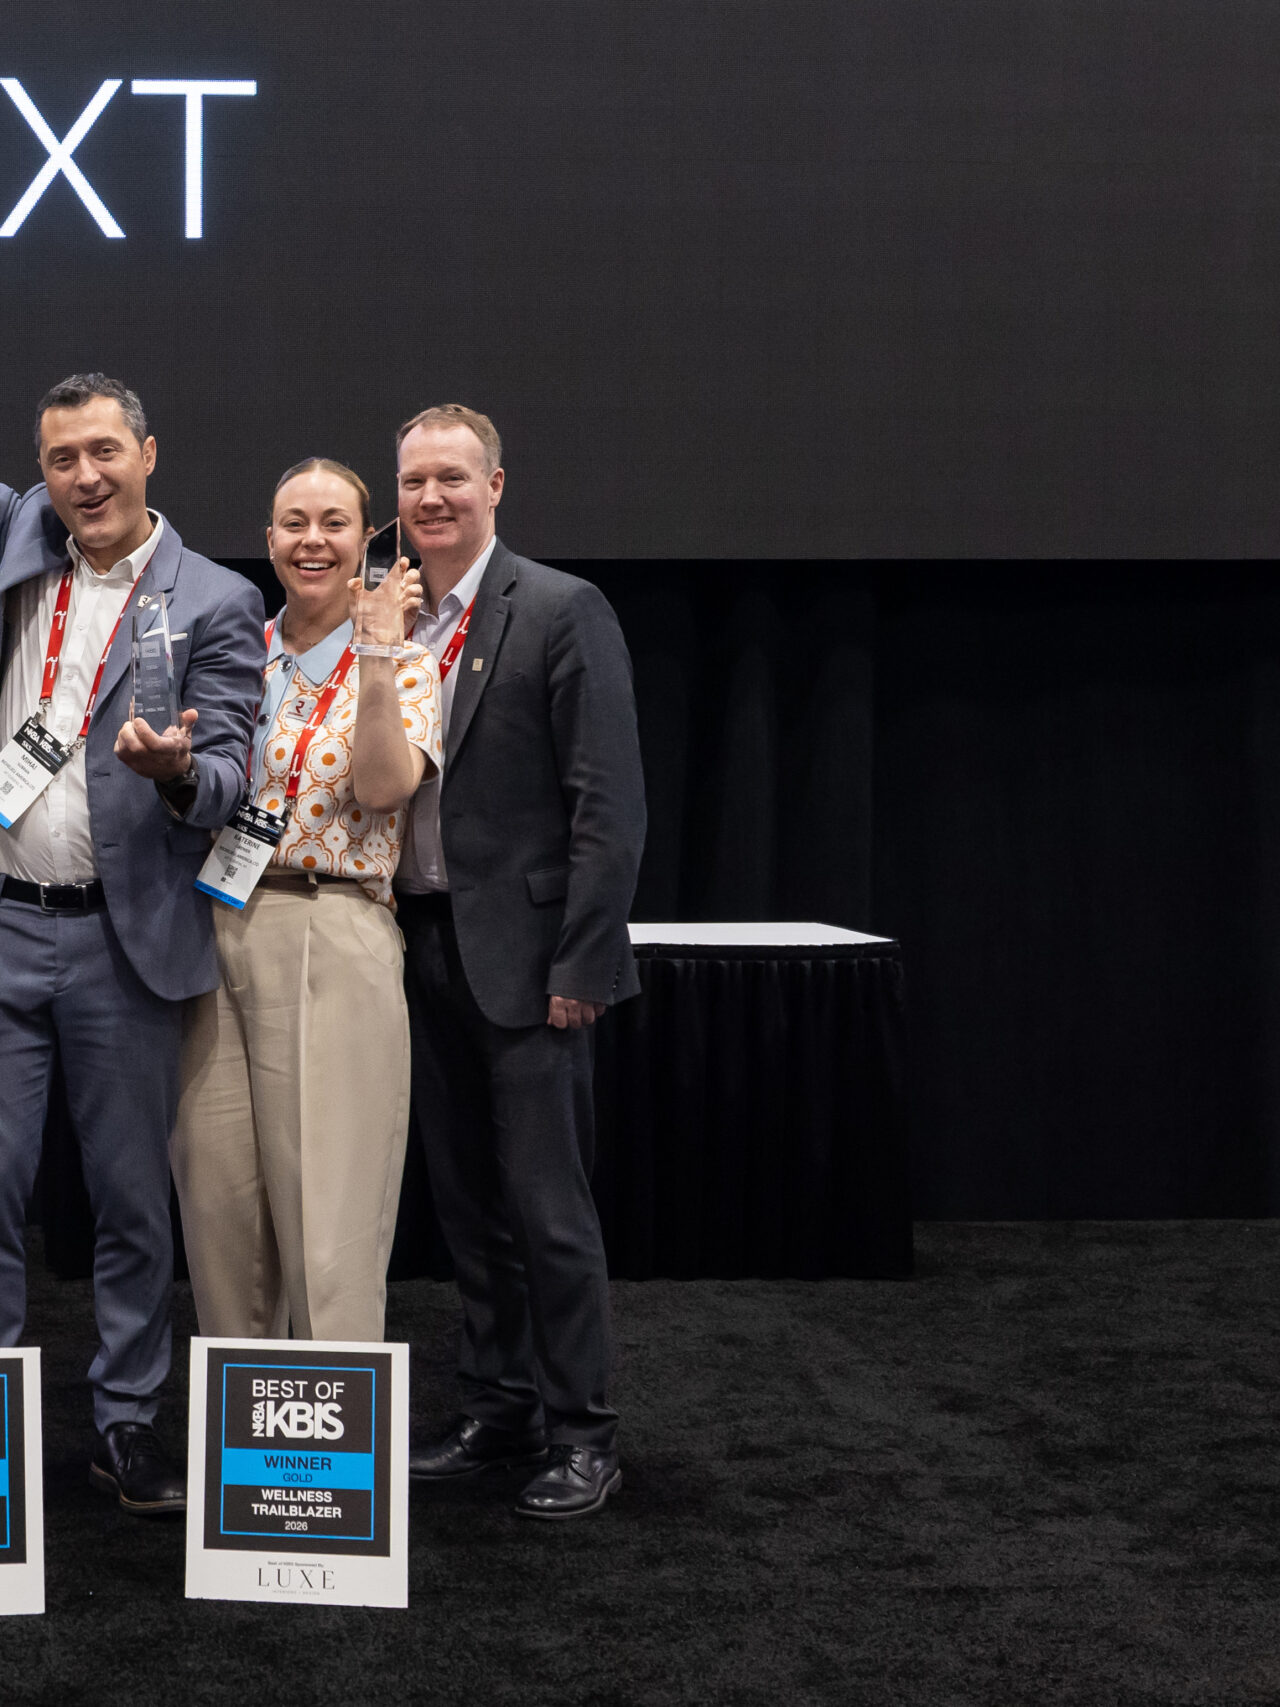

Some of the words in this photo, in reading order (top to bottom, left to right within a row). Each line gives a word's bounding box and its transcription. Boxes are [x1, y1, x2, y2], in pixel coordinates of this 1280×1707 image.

[253, 1380, 308, 1398] BEST
[315, 1382, 344, 1399] OF
[266, 1400, 344, 1440] KBIS
[264, 1455, 332, 1470] WINNER
[283, 1473, 312, 1482] GOLD
[262, 1490, 332, 1502] WELLNESS
[252, 1504, 342, 1518] TRAILBLAZER
[285, 1522, 308, 1530] 2026
[259, 1568, 335, 1589] LUXE
